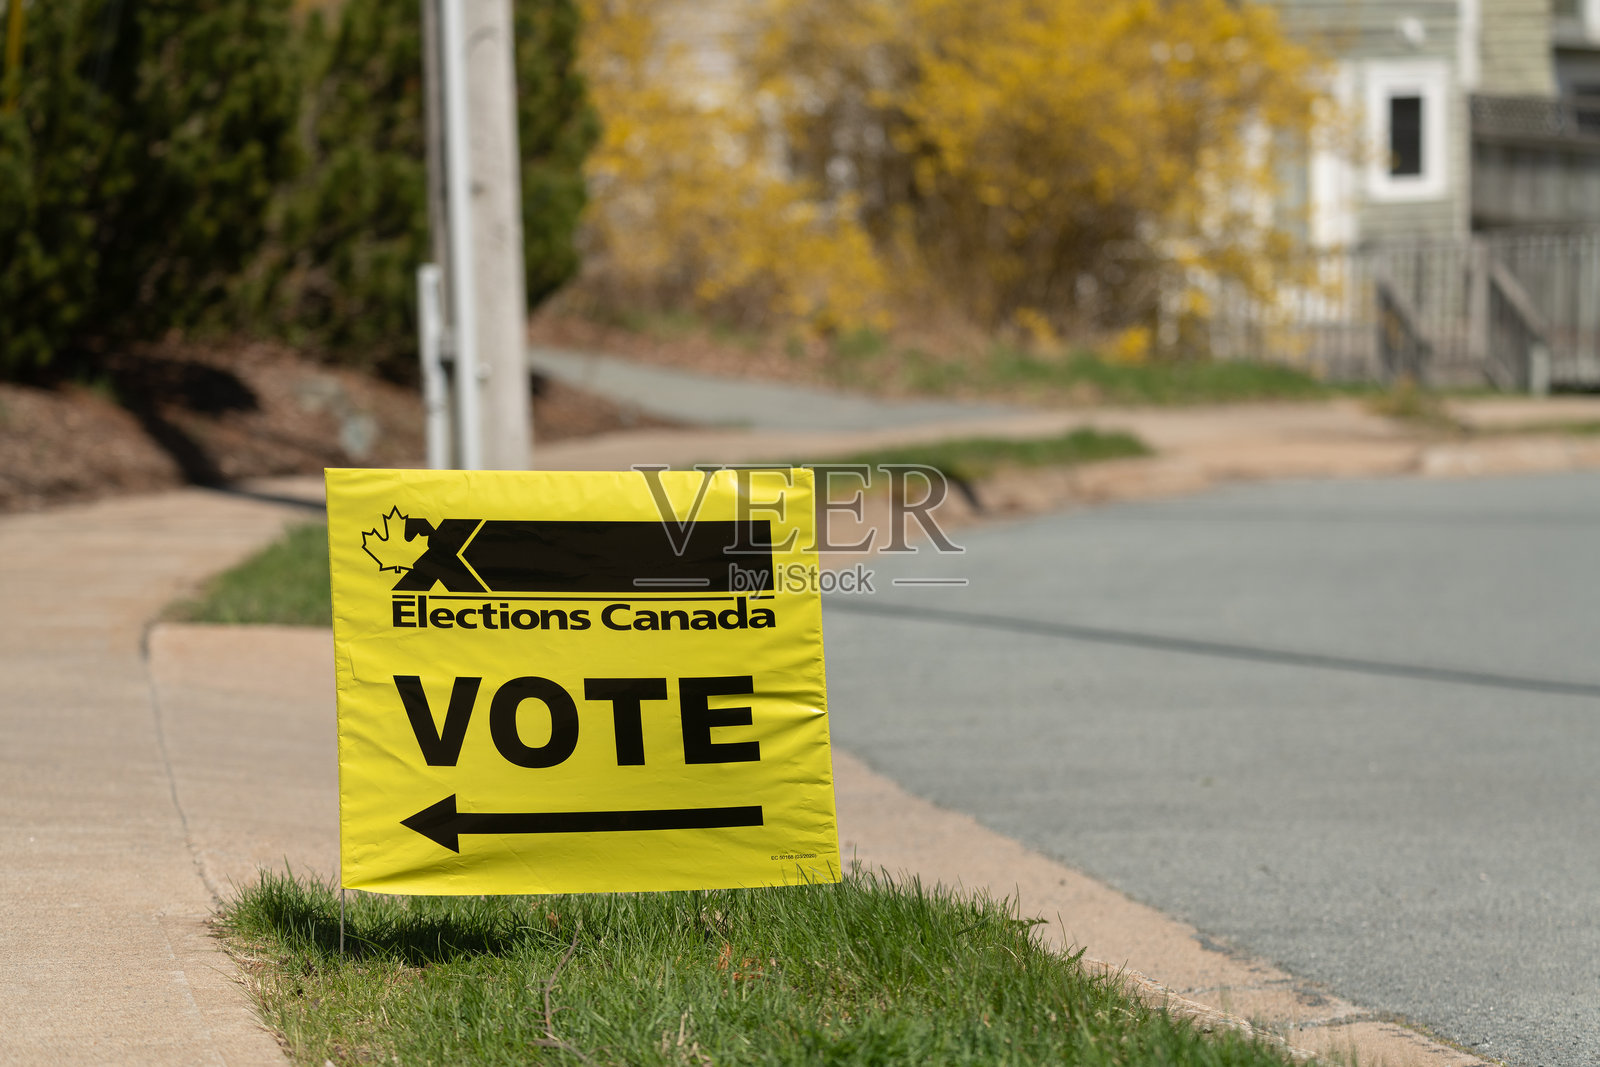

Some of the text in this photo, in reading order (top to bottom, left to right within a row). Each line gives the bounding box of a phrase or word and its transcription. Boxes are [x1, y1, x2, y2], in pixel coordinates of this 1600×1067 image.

[392, 595, 777, 631] Elections Canada
[393, 674, 762, 769] VOTE
